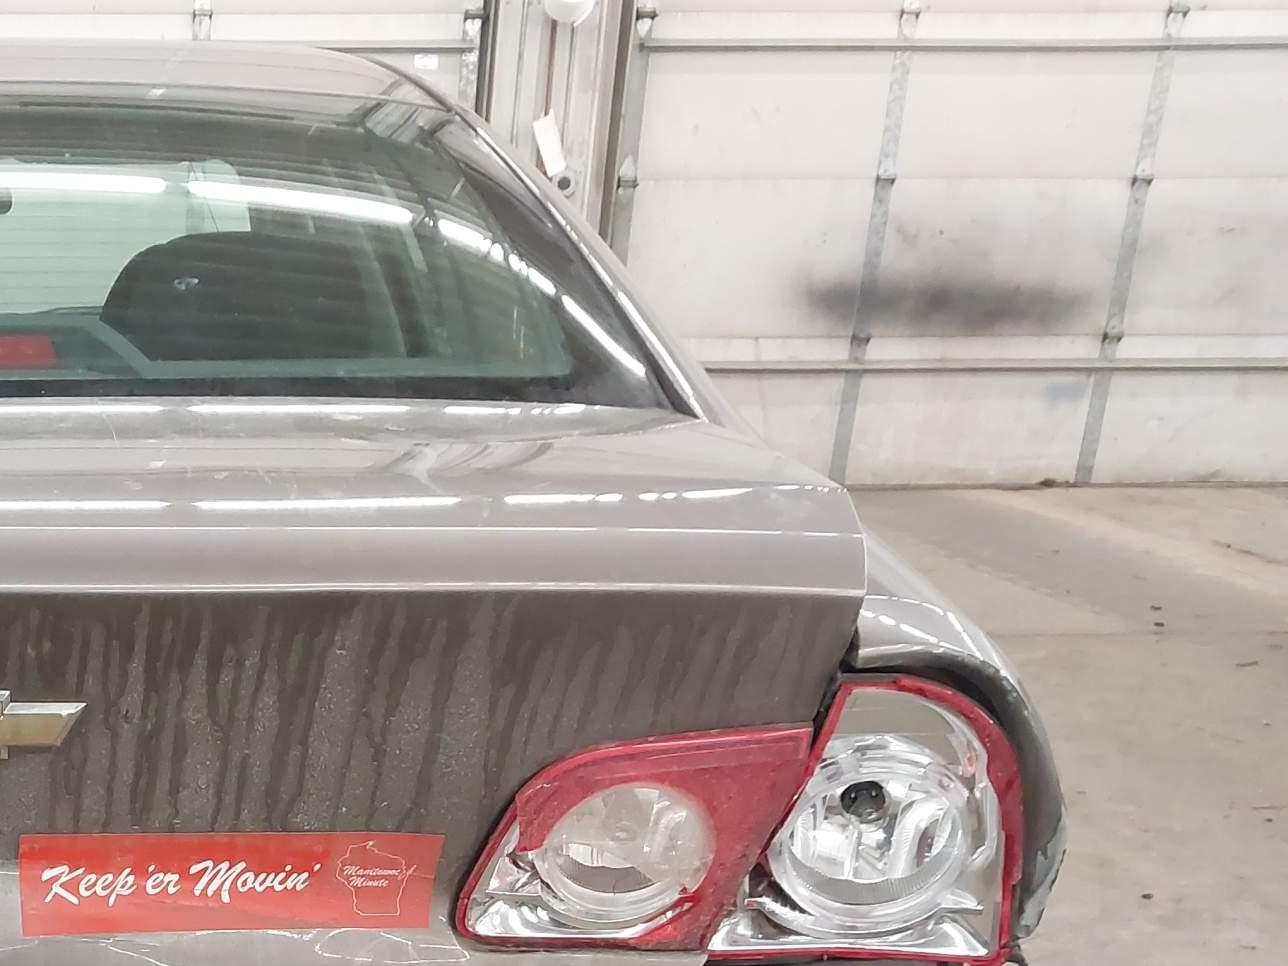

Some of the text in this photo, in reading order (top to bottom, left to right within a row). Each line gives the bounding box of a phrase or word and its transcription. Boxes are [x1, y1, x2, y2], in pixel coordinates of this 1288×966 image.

[41, 864, 137, 906] Keep
[188, 860, 322, 904] Movin'
[349, 876, 389, 888] Minute
